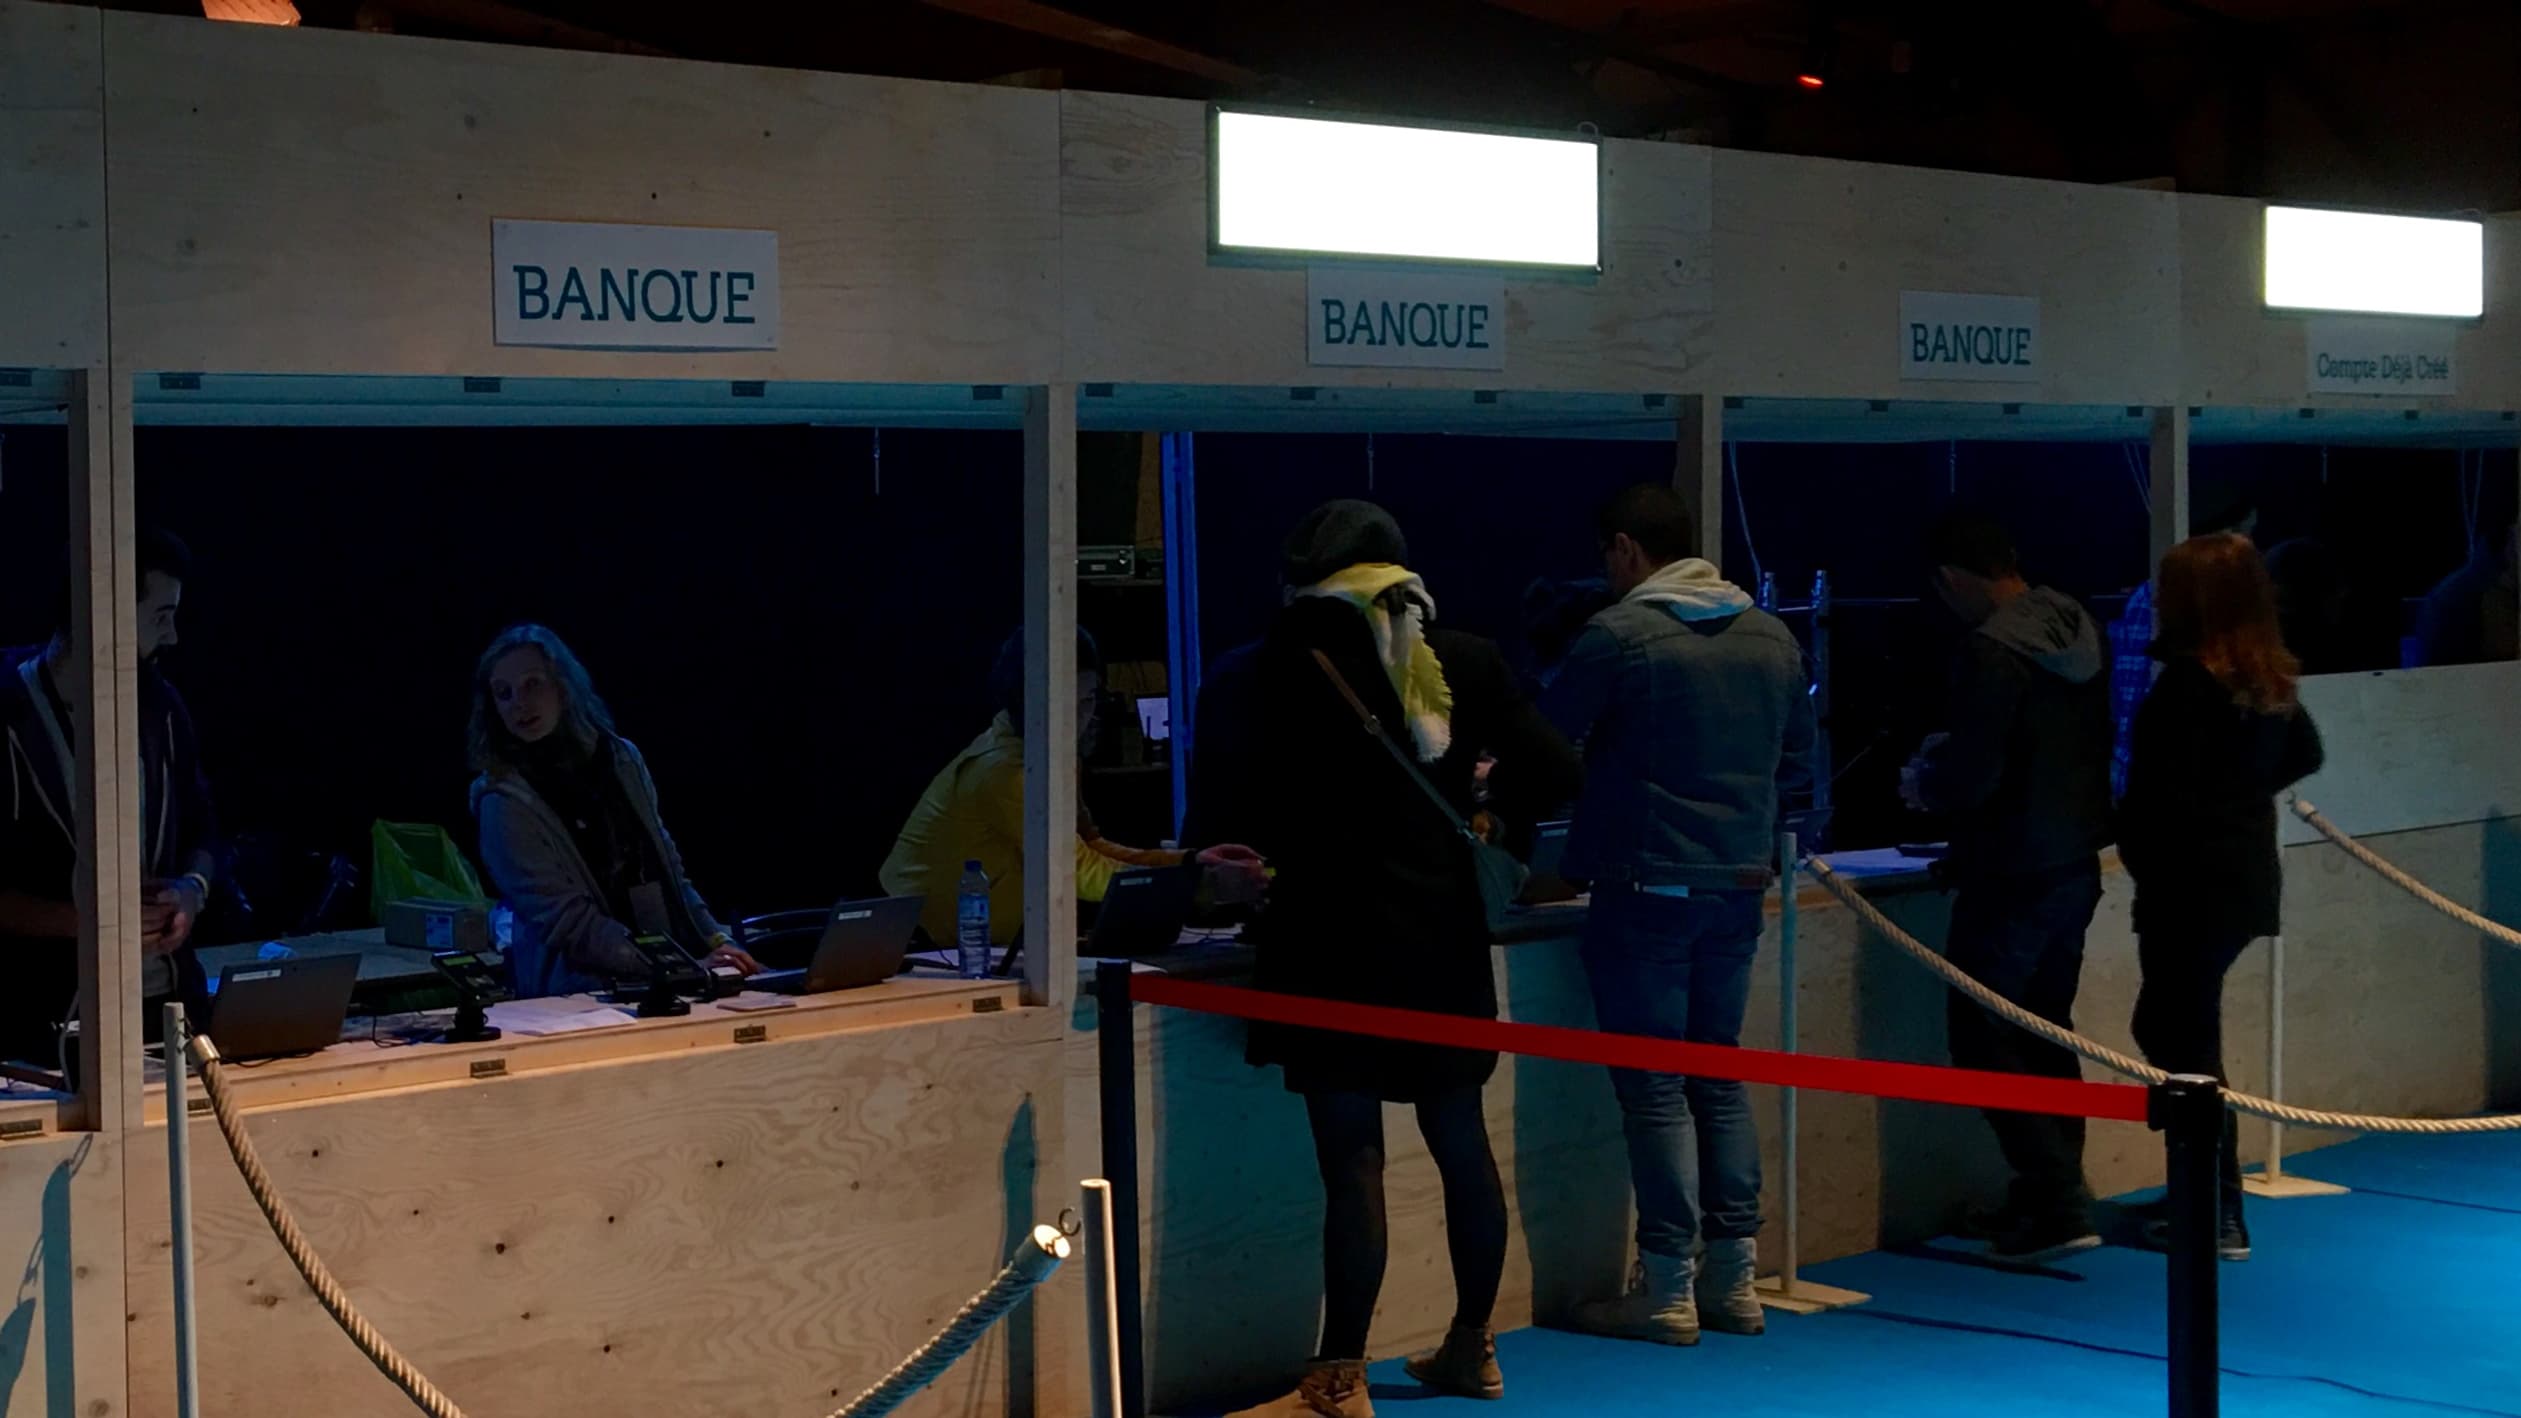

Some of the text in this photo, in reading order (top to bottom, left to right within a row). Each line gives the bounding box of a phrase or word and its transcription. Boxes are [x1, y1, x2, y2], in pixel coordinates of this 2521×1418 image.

[513, 265, 756, 324] BANQUE
[1321, 299, 1489, 348] BANQUE
[1911, 323, 2031, 365] BANQUE
[2317, 352, 2377, 383] Compte
[2381, 354, 2413, 383] Déjà
